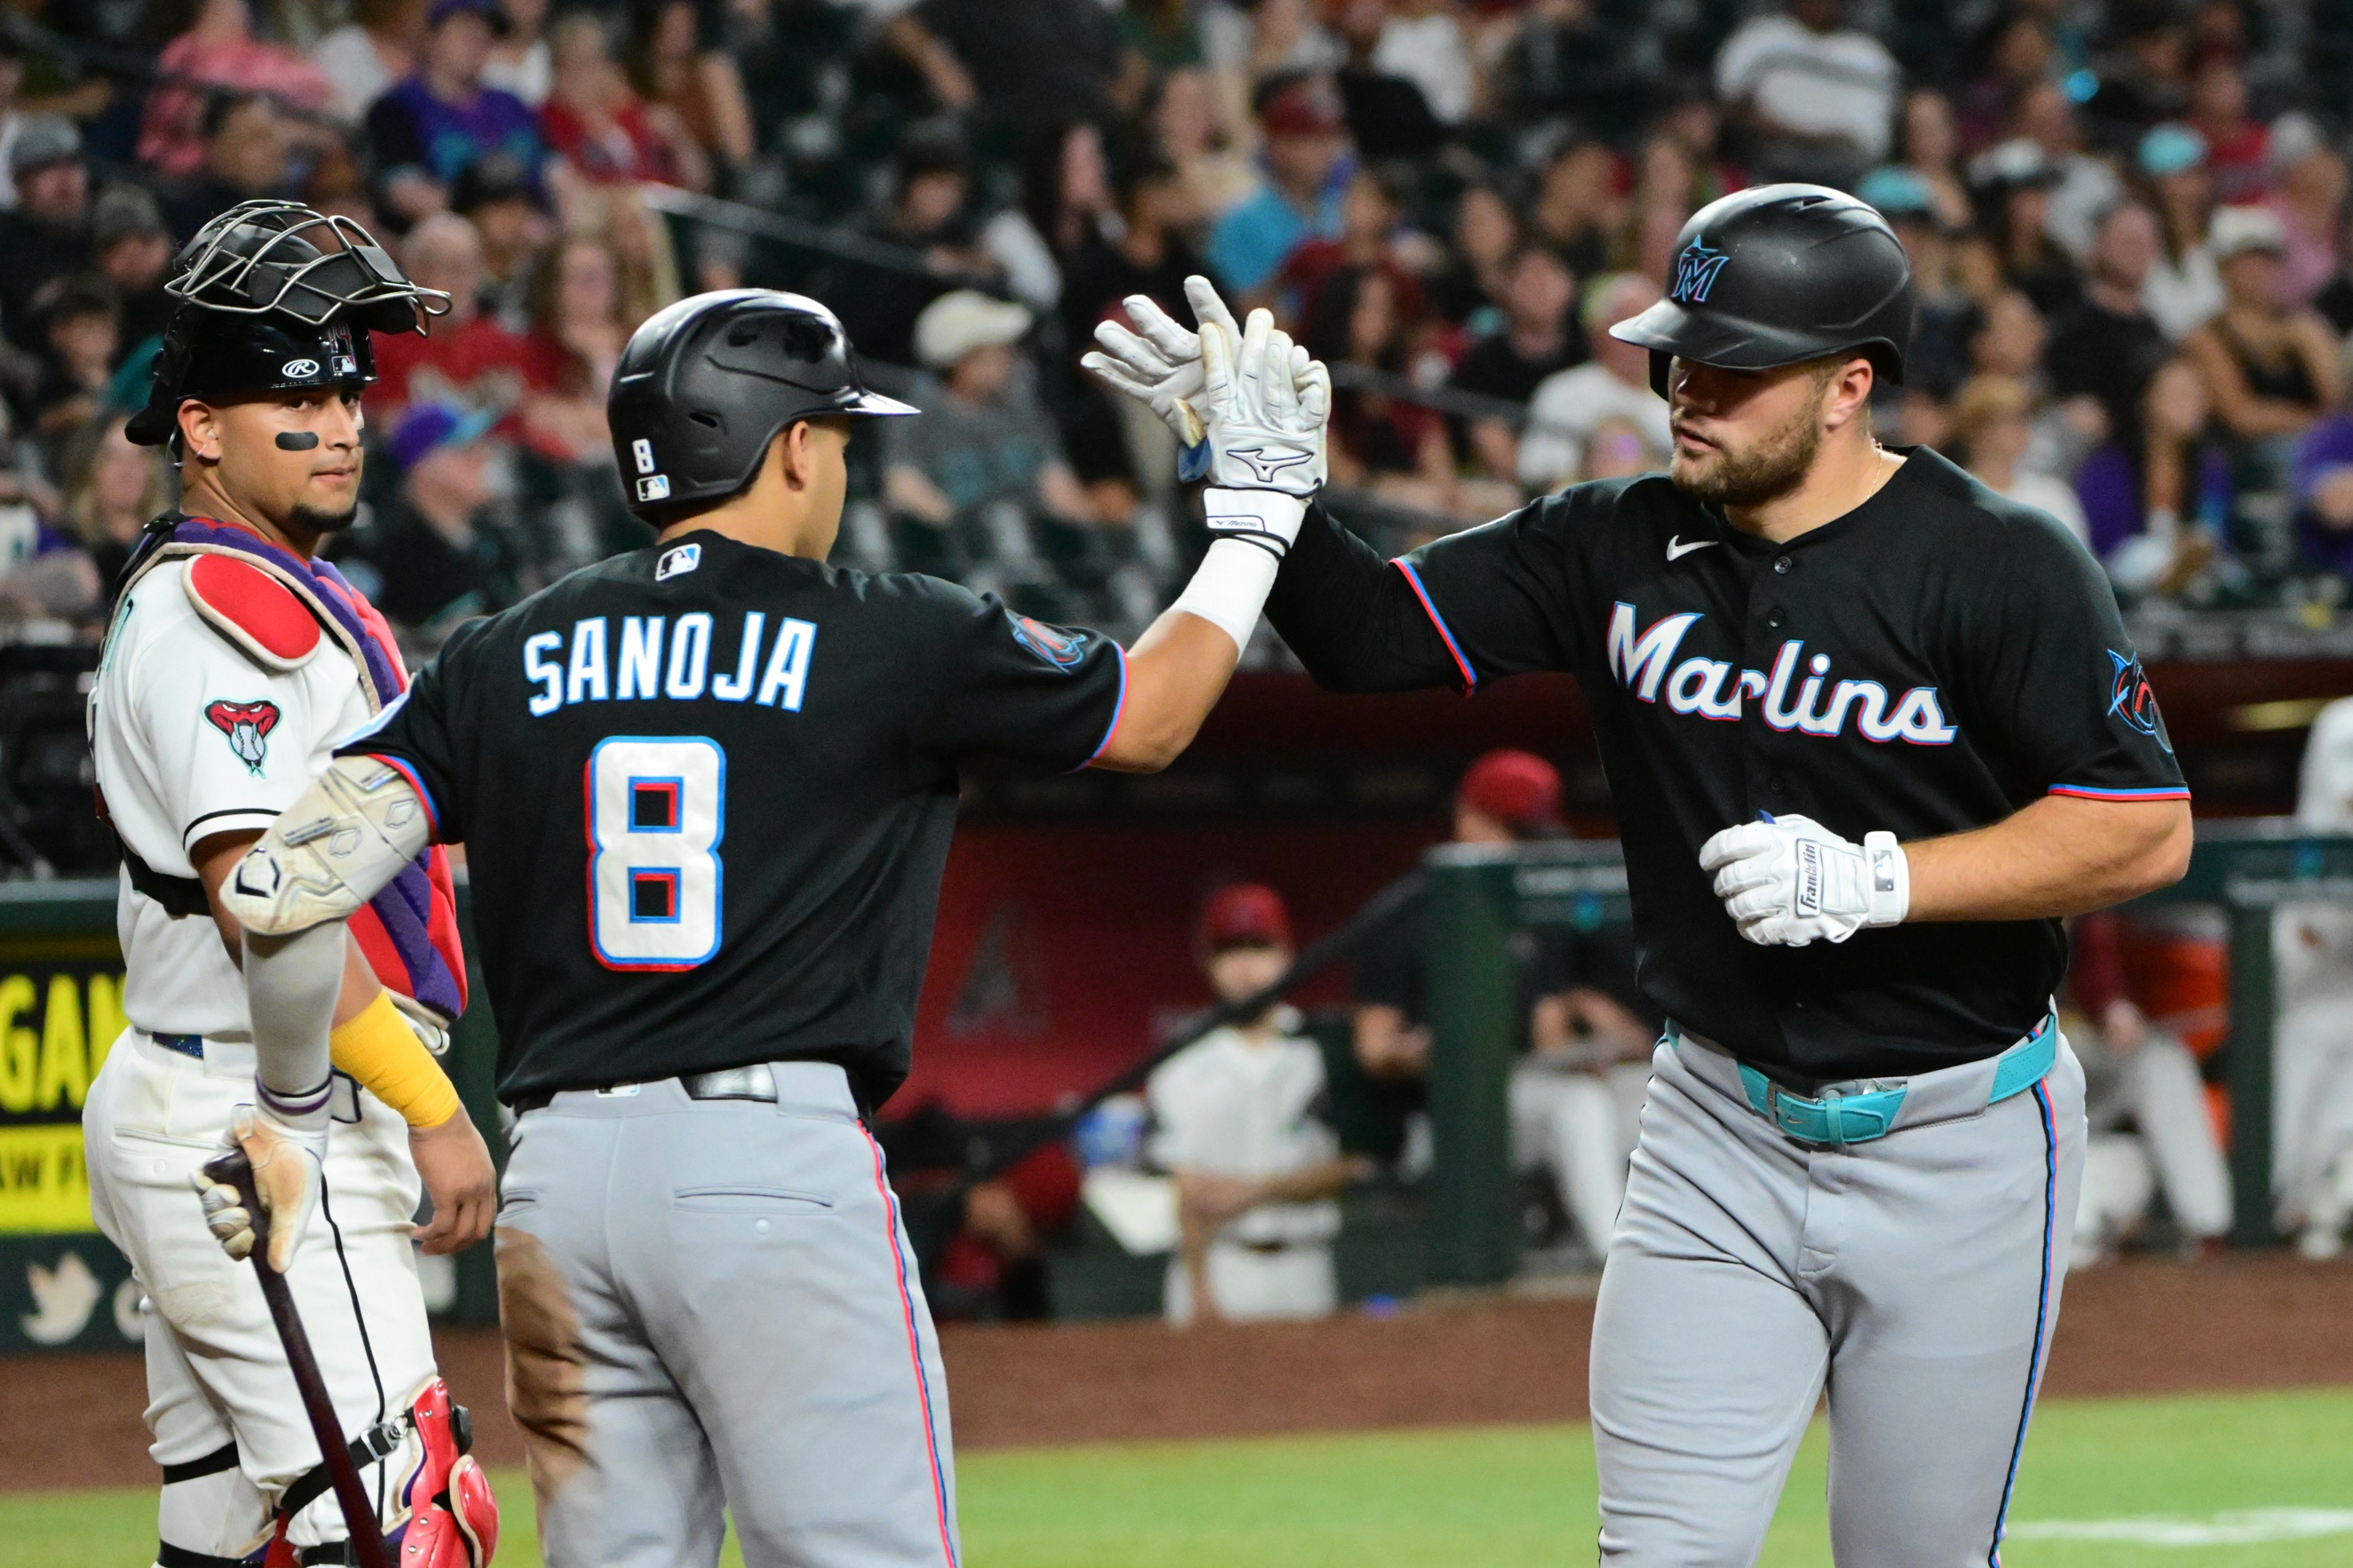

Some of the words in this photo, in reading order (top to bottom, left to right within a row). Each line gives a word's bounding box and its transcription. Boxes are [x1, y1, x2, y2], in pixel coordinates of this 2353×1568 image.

[632, 438, 655, 474] 8
[524, 611, 818, 717] SANOJA
[1607, 600, 1958, 746] Marlins
[583, 735, 727, 972] 8
